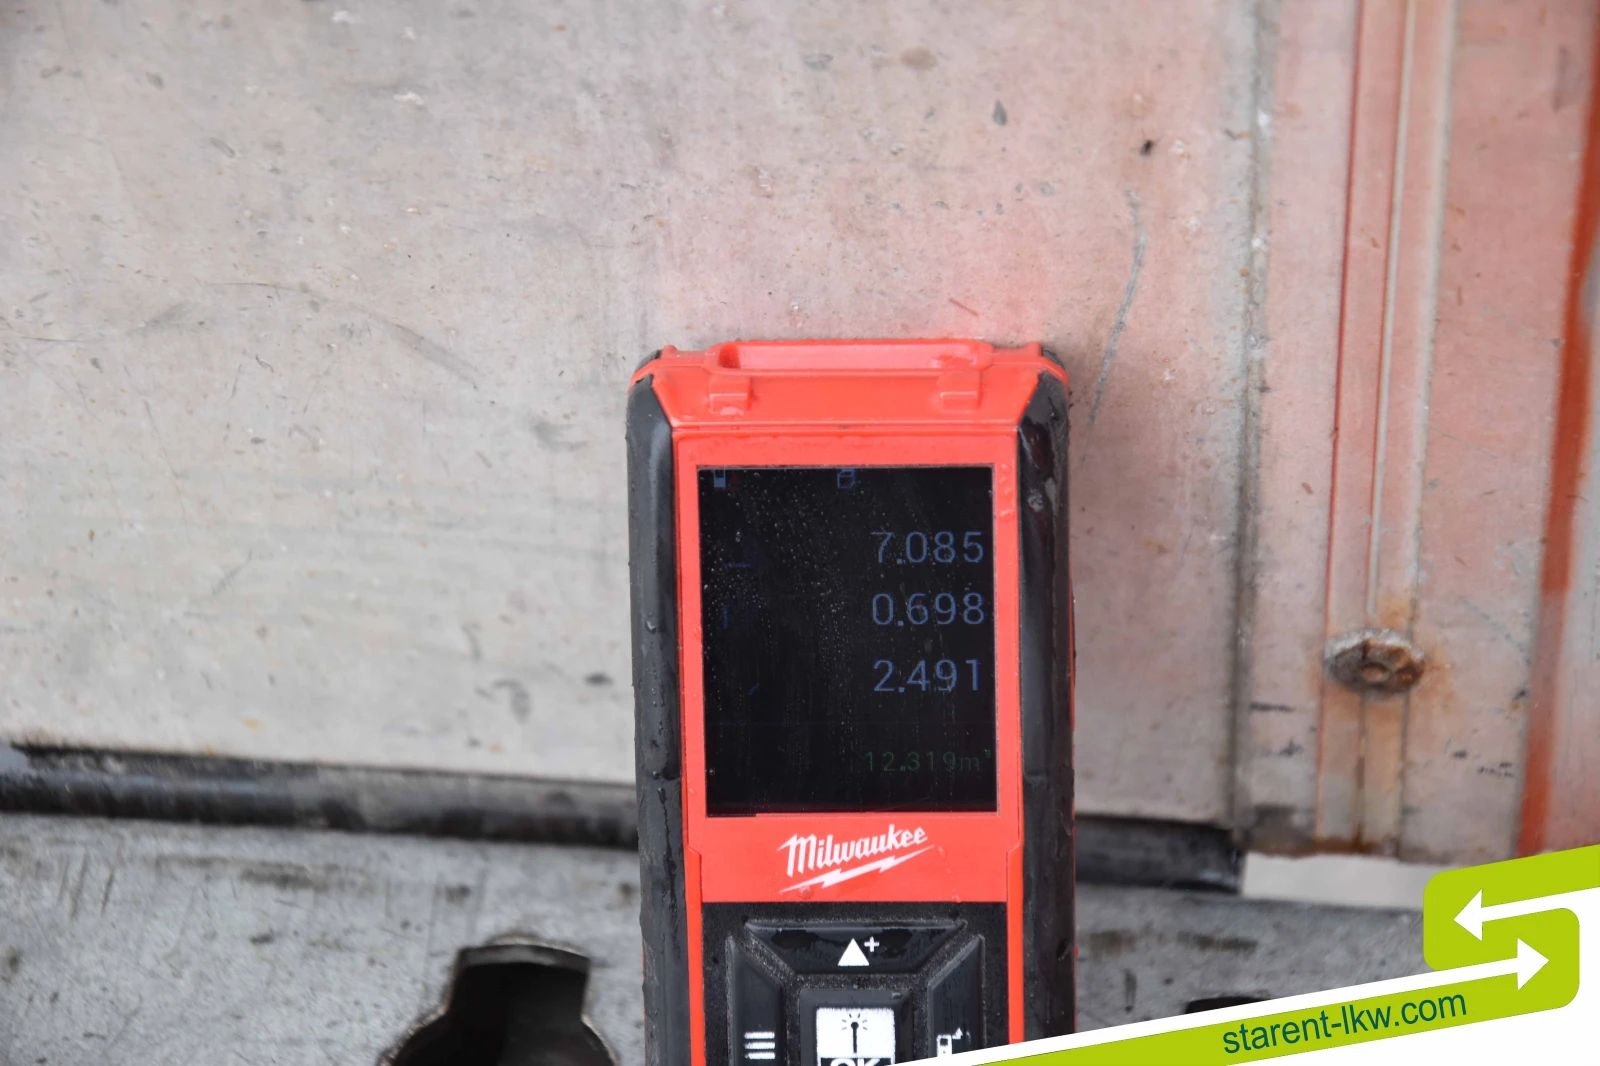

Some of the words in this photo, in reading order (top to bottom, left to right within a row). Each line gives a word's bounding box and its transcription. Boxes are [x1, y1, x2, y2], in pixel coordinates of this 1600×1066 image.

[871, 530, 984, 564] 7.085
[872, 592, 985, 626] 0.698
[873, 659, 981, 692] 2.491
[777, 824, 928, 878] Milwaukee
